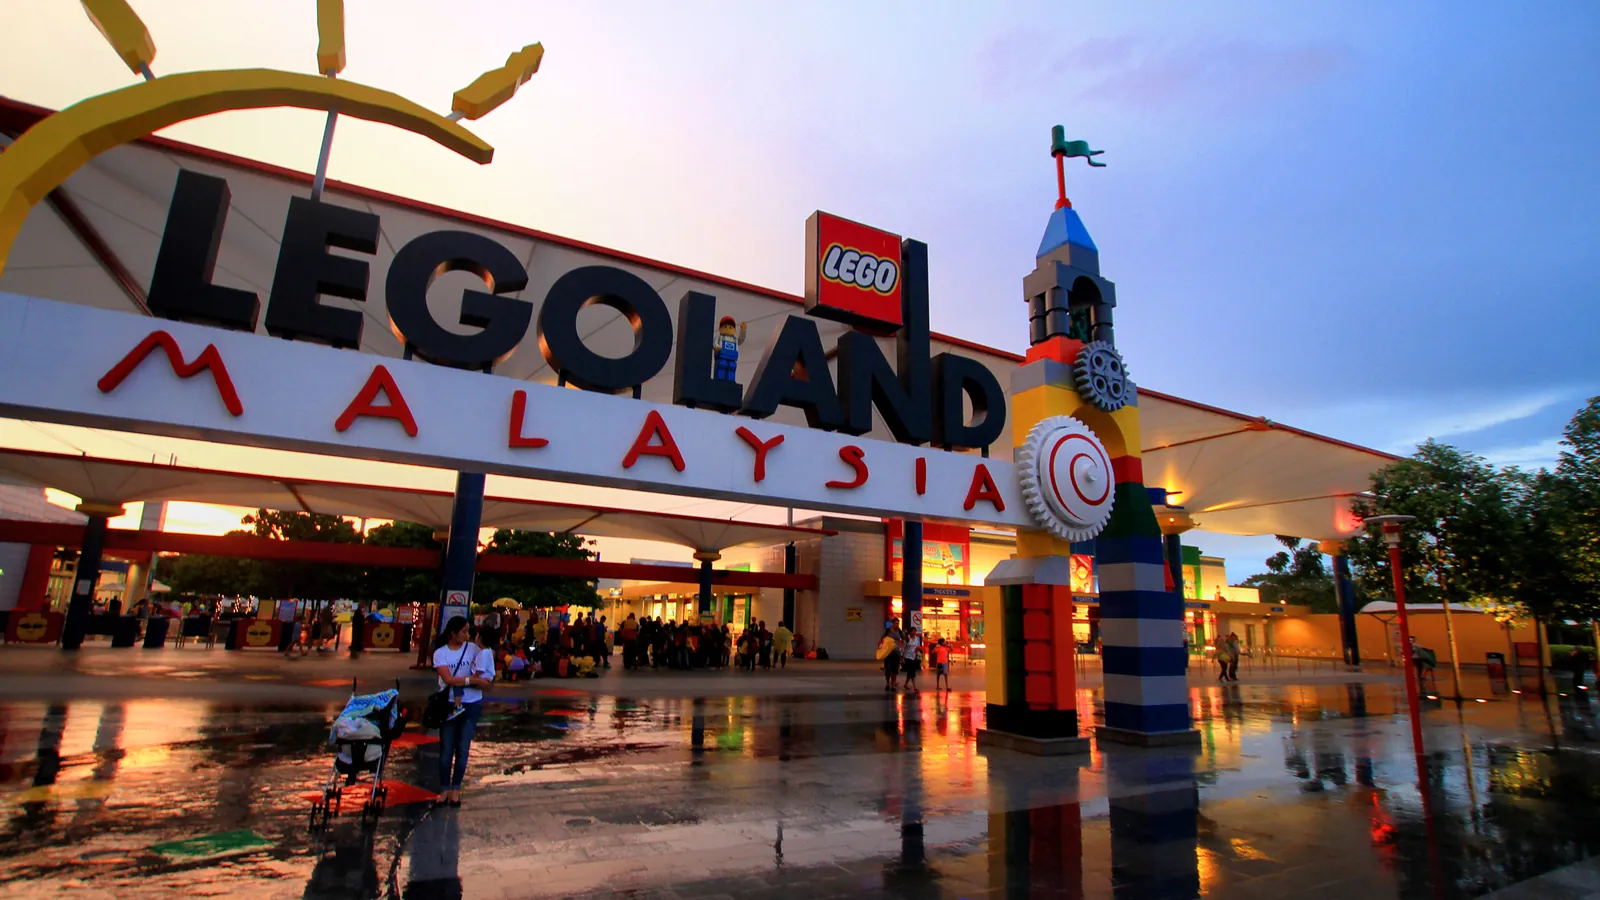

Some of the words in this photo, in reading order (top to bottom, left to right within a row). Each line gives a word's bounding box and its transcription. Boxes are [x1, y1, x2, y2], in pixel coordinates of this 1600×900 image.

[147, 168, 1006, 449] LEGOLAND
[822, 243, 899, 295] LEGO
[97, 330, 1005, 512] MALAYSIA
